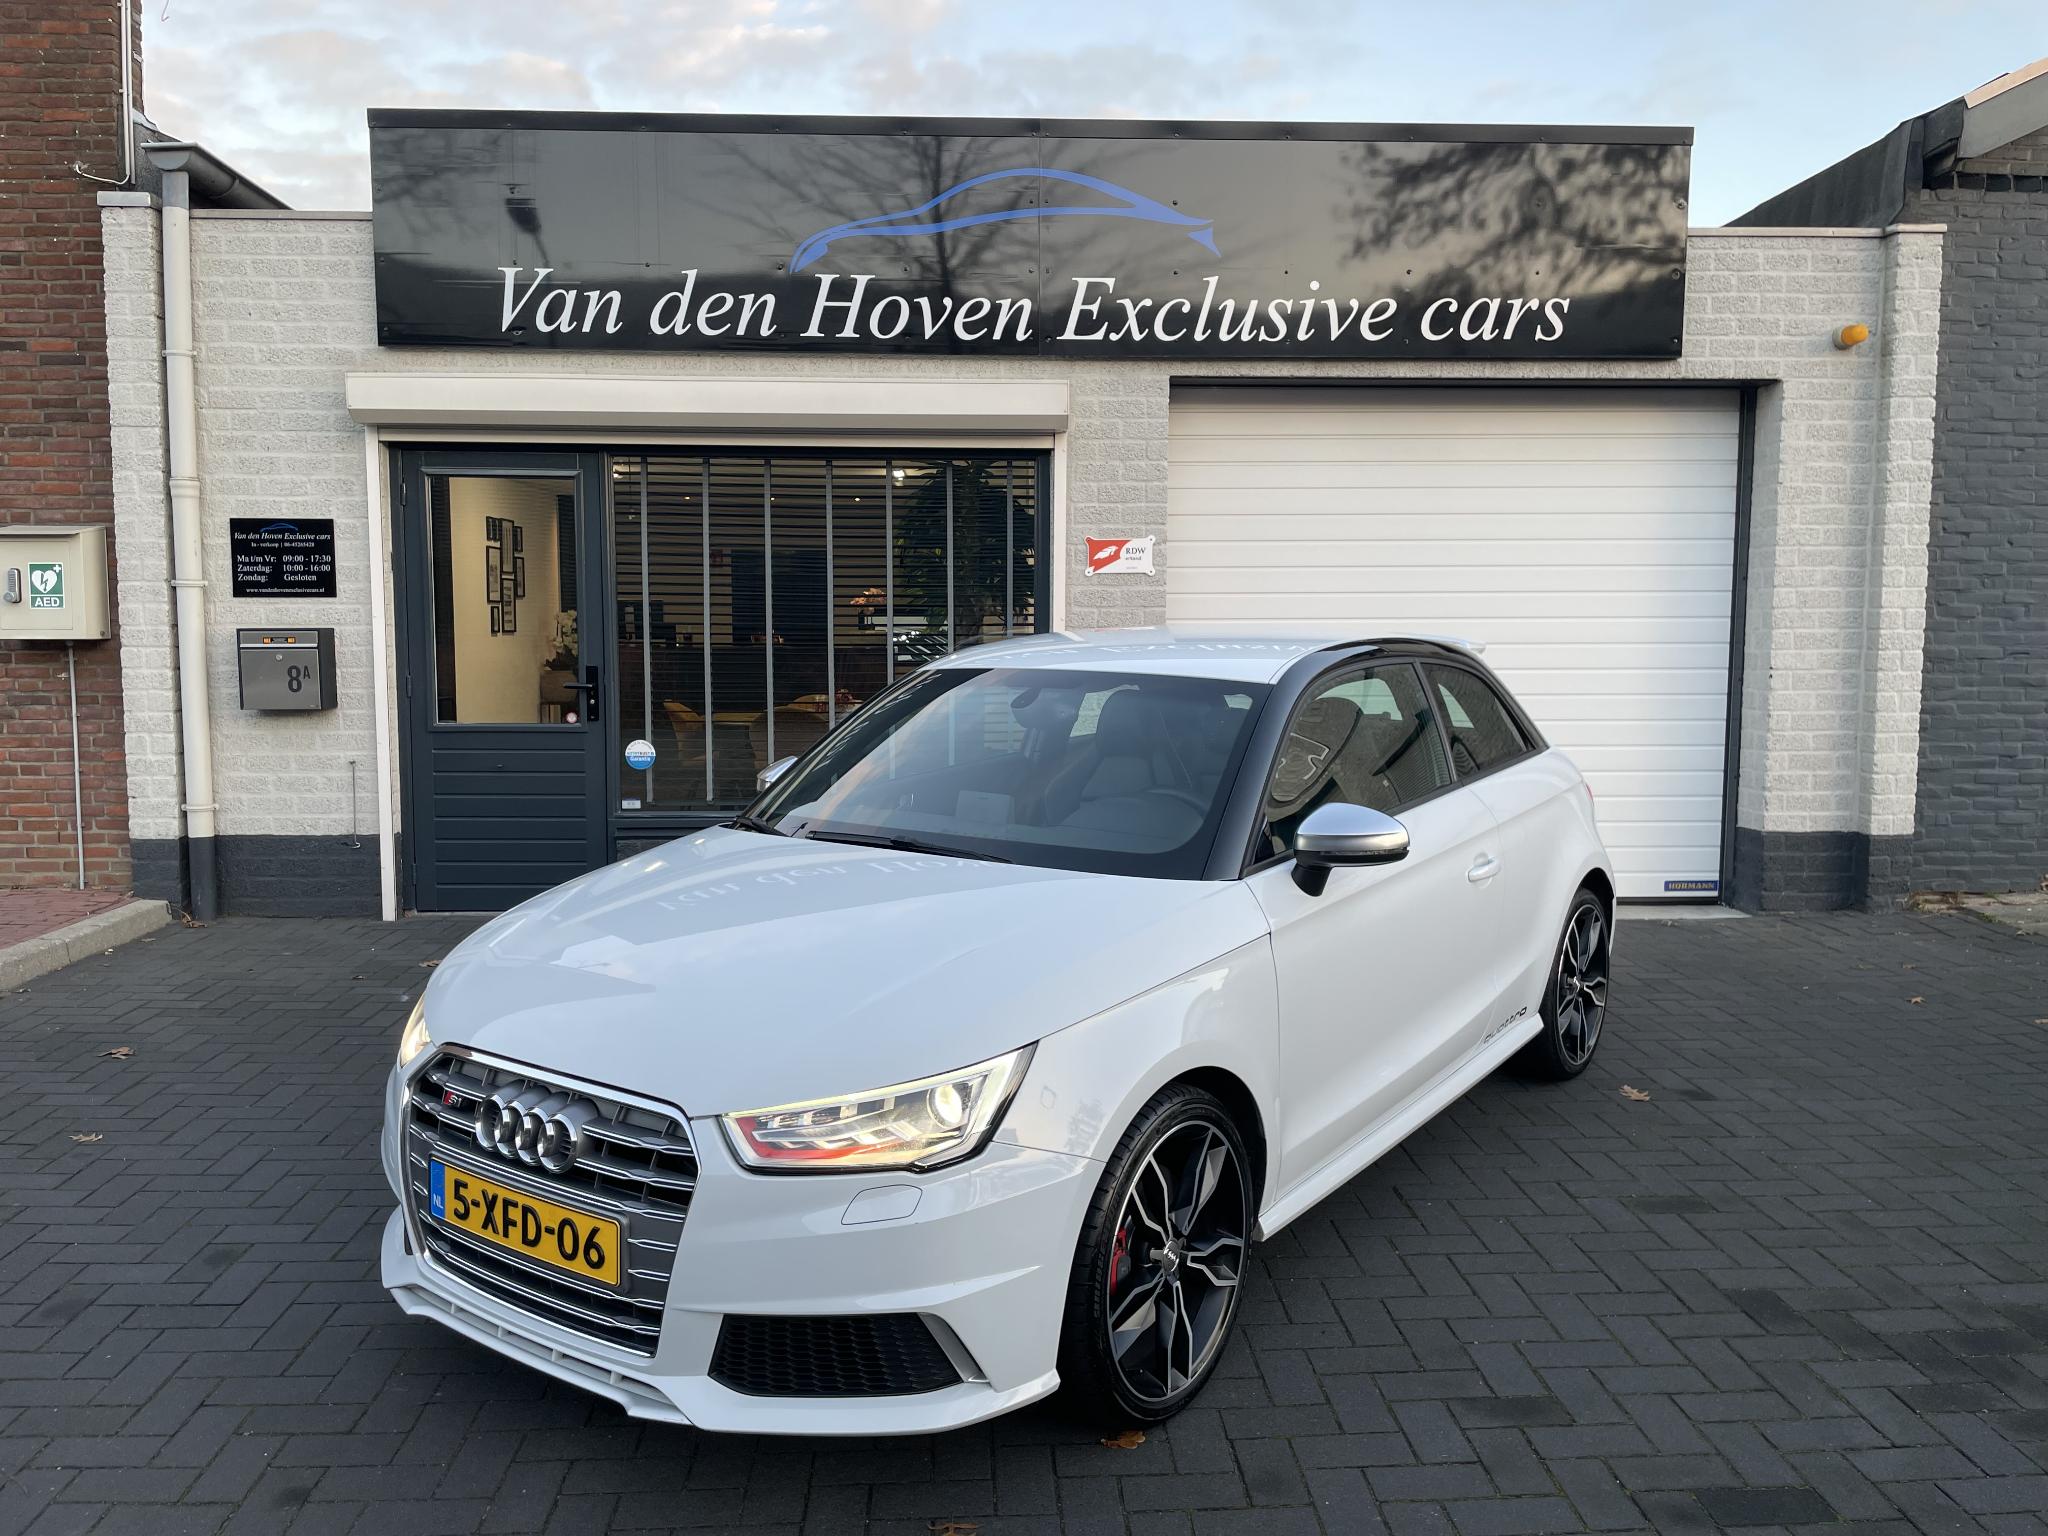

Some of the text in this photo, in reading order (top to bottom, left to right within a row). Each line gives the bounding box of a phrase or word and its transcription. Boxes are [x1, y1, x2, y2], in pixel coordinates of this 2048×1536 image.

[498, 267, 1570, 342] Van den Hoven Exclusive cars
[284, 532, 316, 540] Exclusive
[237, 554, 249, 562] Ma
[250, 554, 263, 562] t/m
[264, 554, 277, 562] Vr:
[282, 554, 304, 562] 09:00
[310, 554, 332, 562] 17:30
[237, 564, 273, 573] Zaterdag:
[283, 564, 304, 572] 10:00
[310, 564, 331, 572] 16:00
[237, 573, 317, 582] Zondag: Gesloten
[34, 597, 60, 607] AED
[433, 1194, 444, 1210] NL
[453, 1177, 606, 1270] 5-XFD-06
